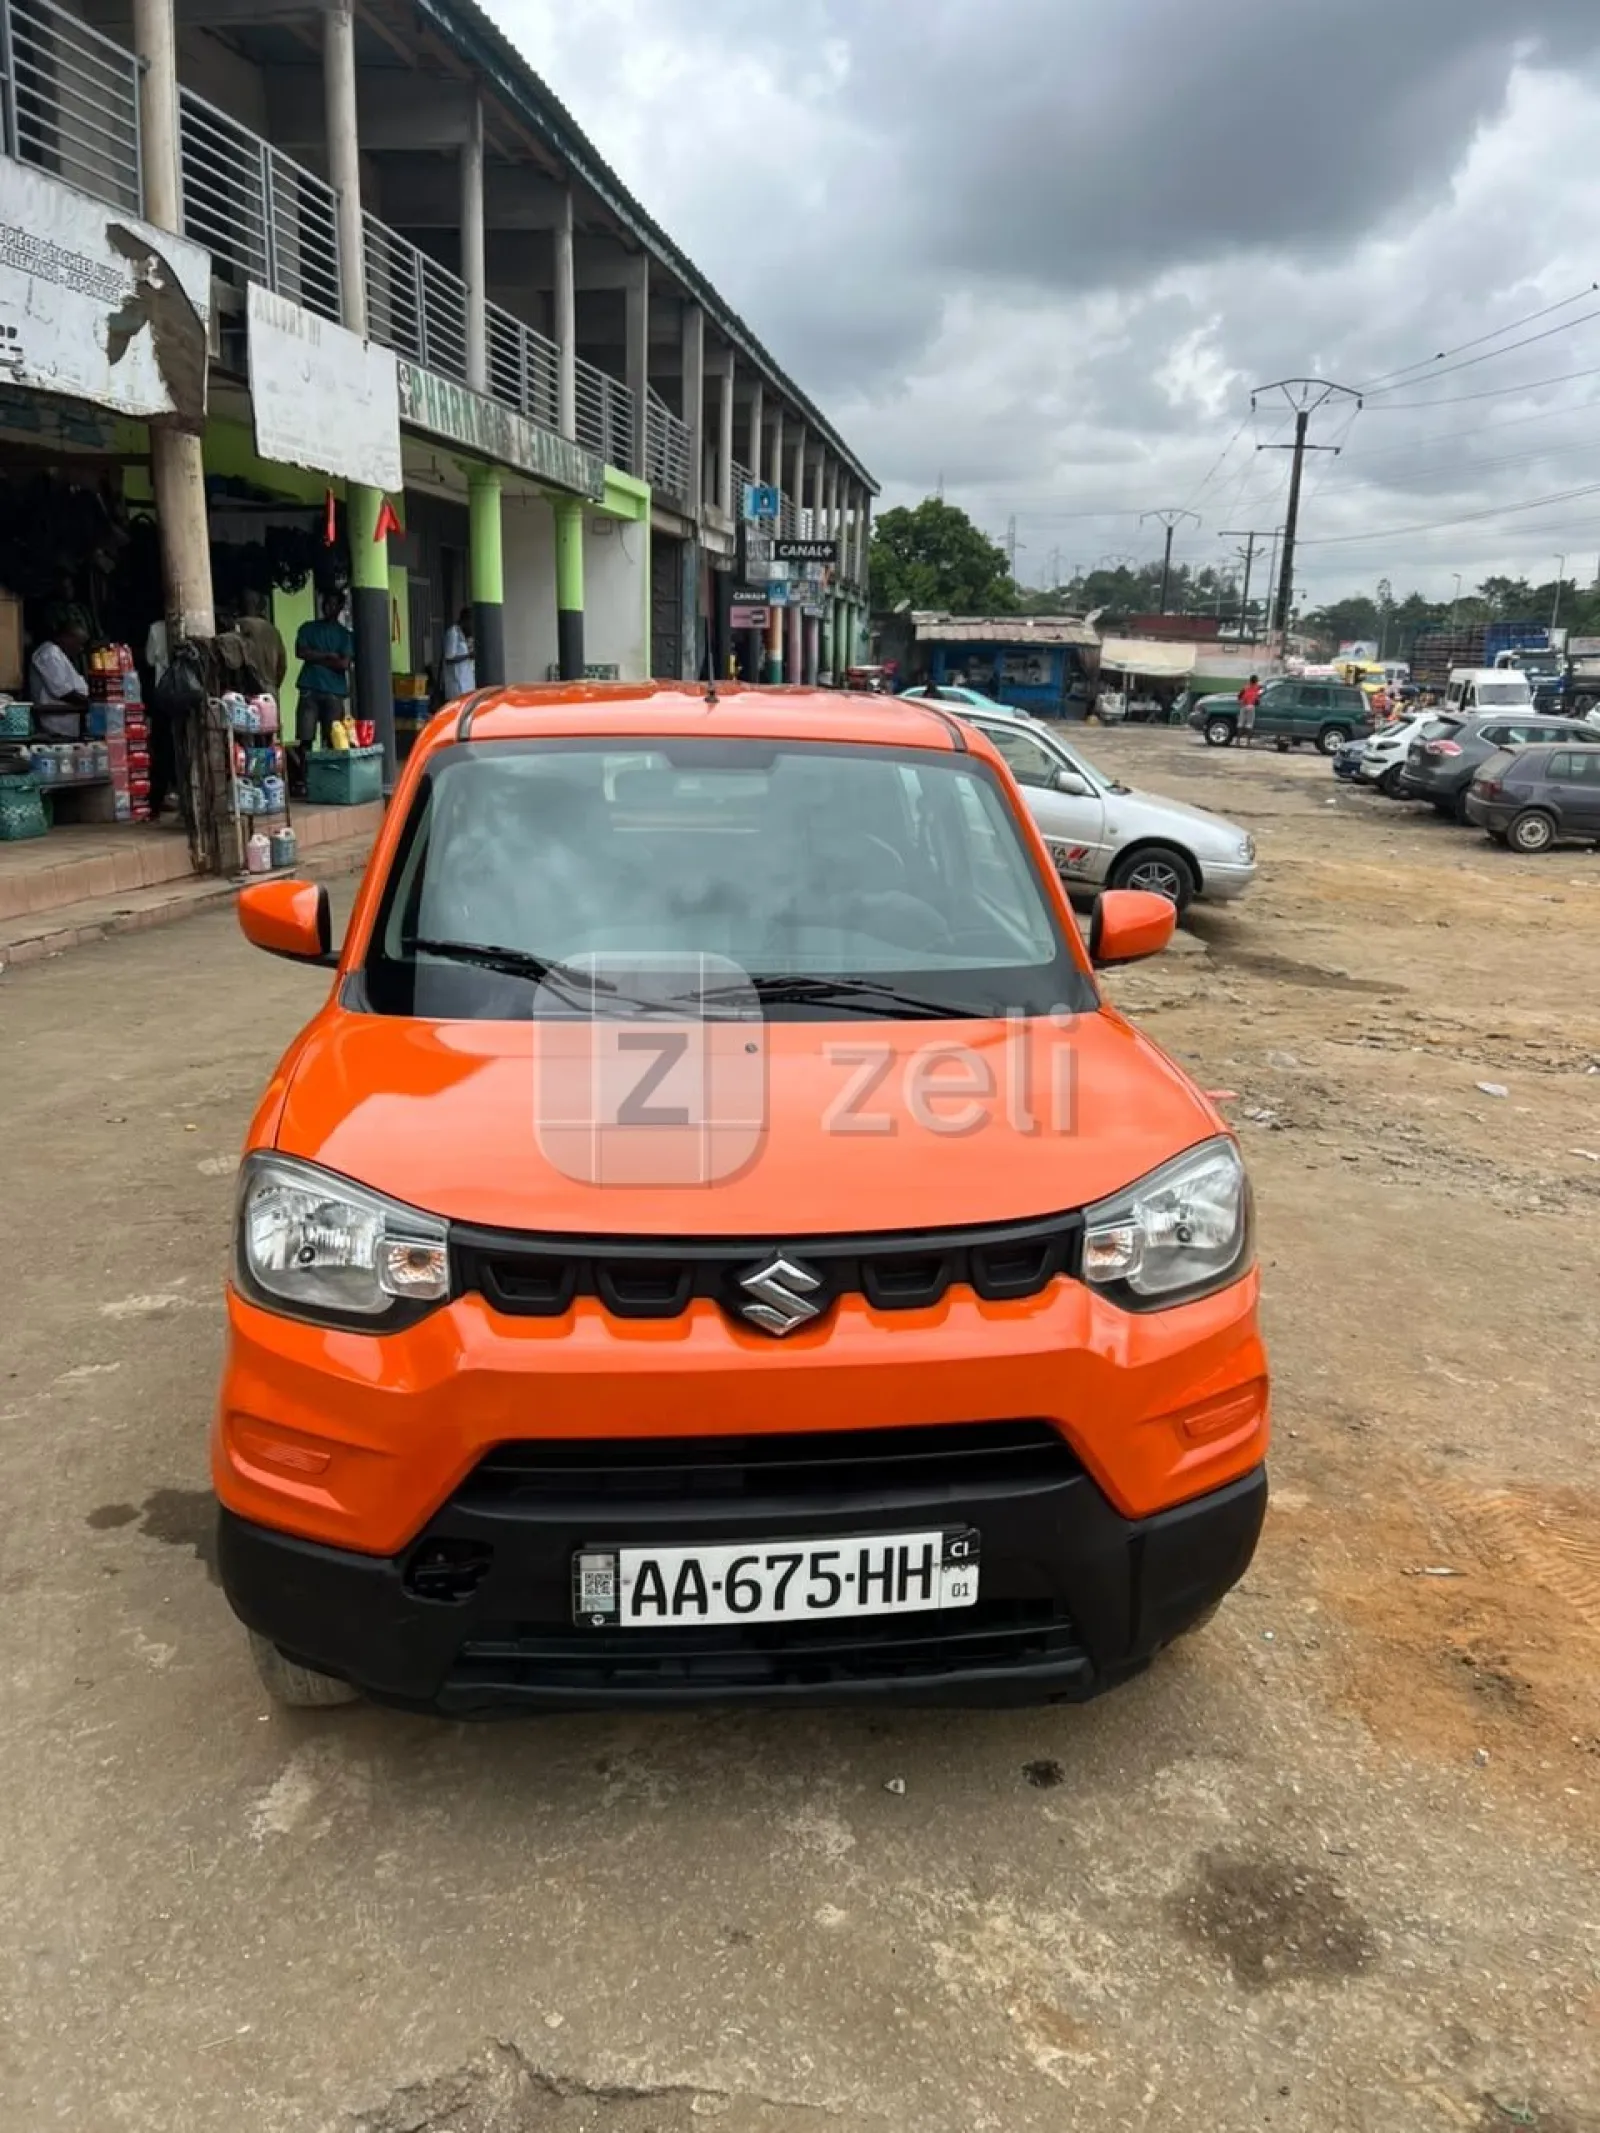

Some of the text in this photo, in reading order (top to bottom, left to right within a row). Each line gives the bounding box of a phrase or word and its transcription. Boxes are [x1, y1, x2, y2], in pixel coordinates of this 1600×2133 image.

[779, 544, 833, 557] CANAL+
[949, 1541, 969, 1557] CI
[631, 1543, 934, 1616] AA-675-HH
[951, 1582, 970, 1598] 01
